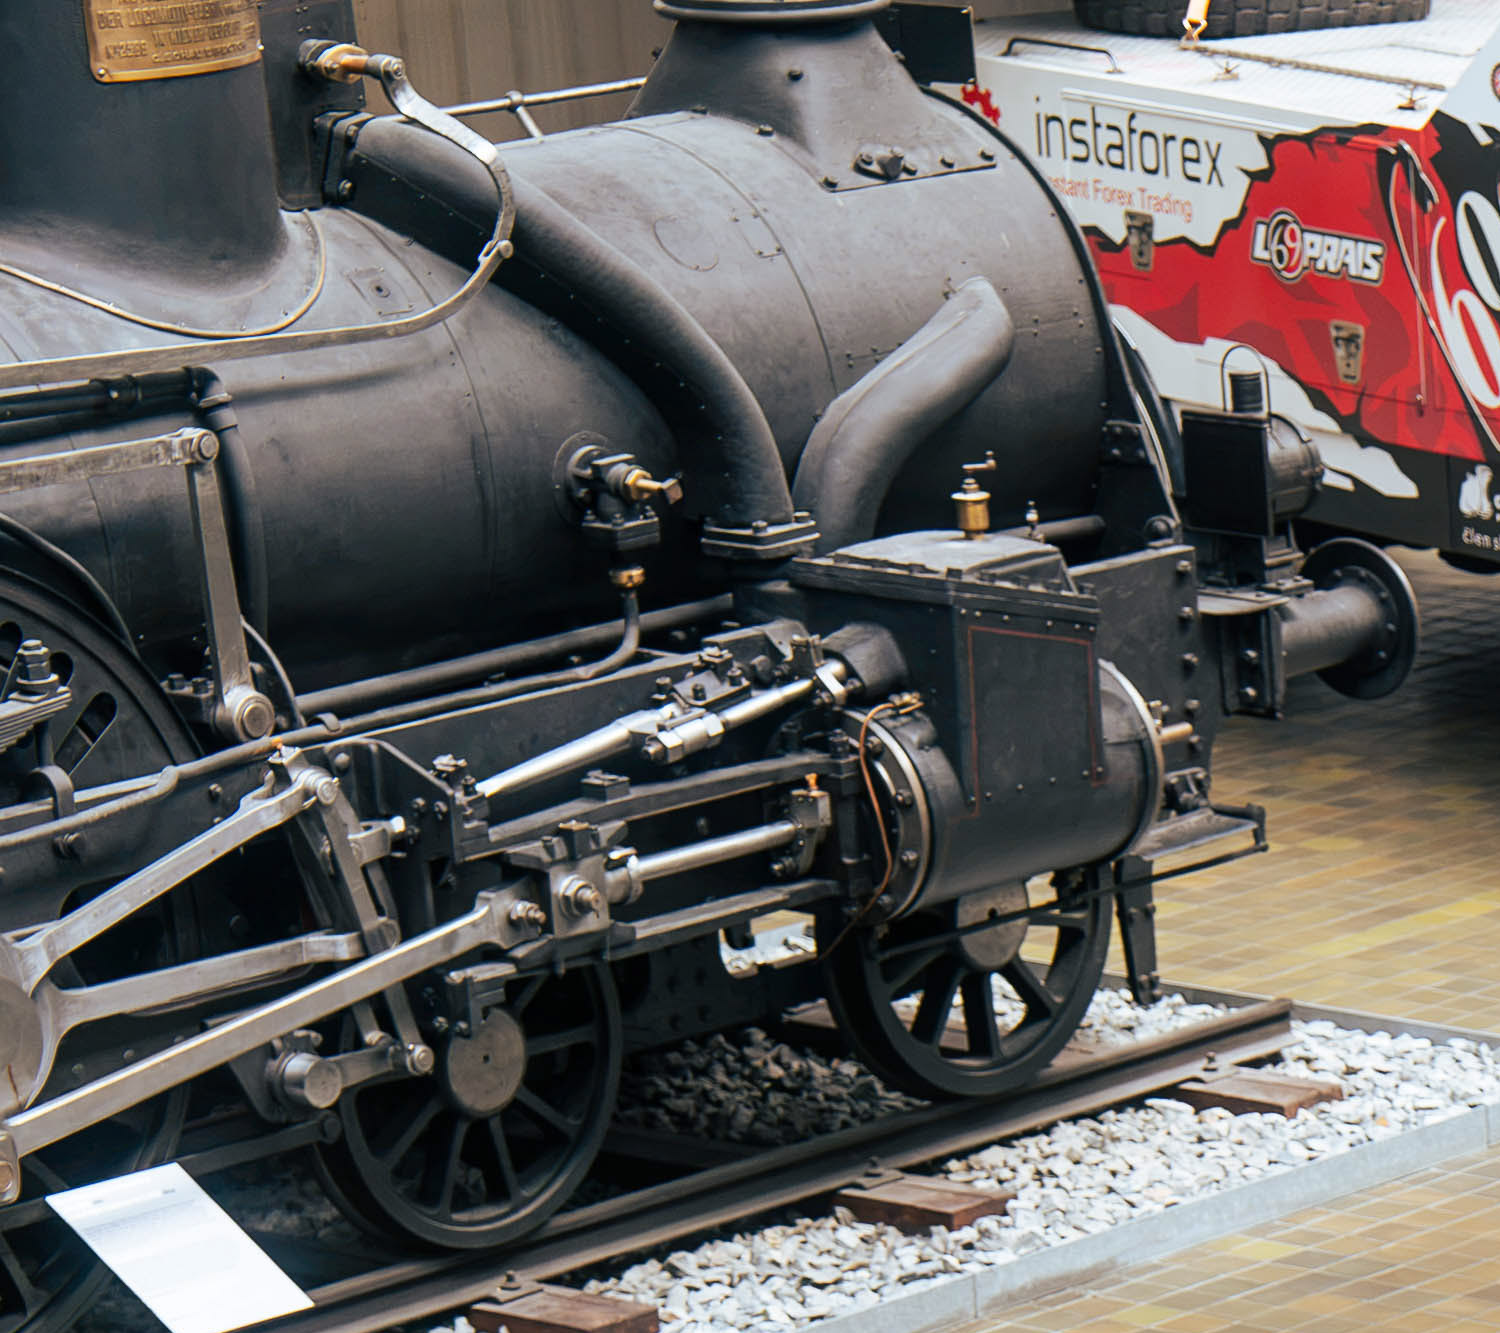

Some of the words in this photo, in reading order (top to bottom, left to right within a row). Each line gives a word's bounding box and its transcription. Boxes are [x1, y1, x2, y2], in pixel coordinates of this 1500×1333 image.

[1035, 96, 1224, 188] instaforex
[1093, 179, 1134, 207] Forex
[1137, 188, 1193, 224] Trading
